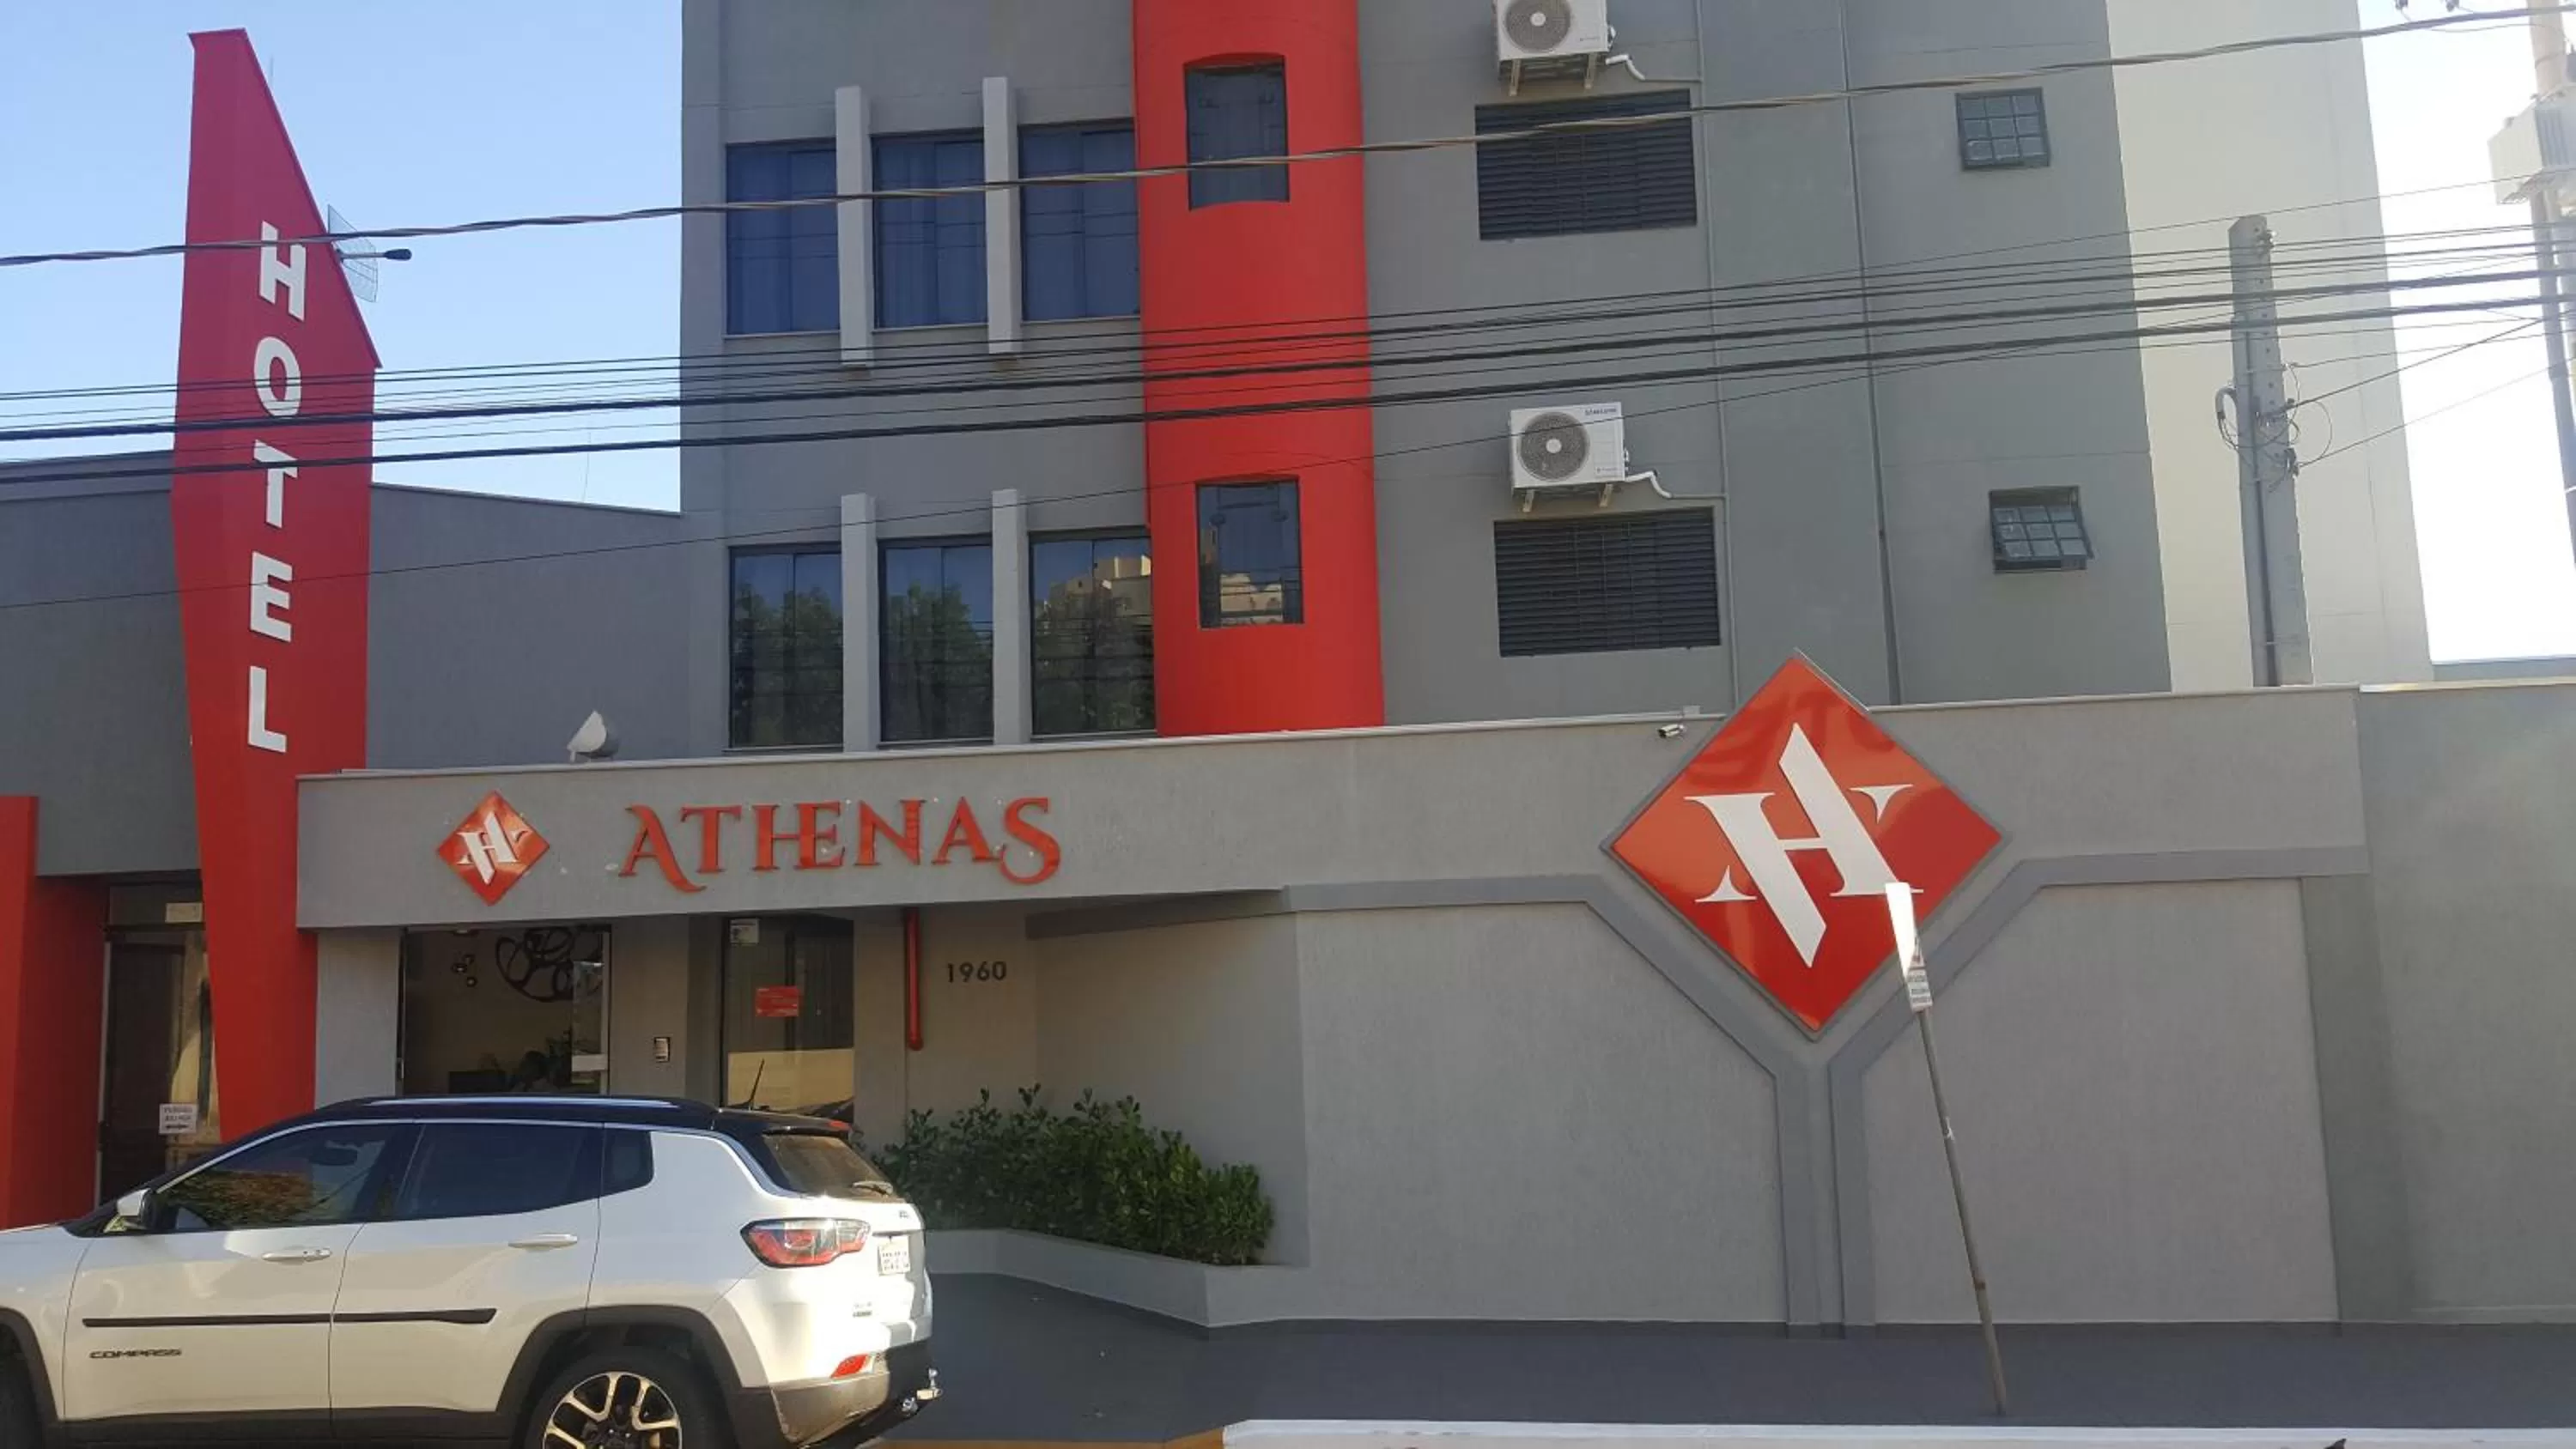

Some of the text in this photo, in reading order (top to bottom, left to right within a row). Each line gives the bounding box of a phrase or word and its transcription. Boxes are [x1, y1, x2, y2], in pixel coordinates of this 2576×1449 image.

[247, 221, 307, 753] HOTEL
[618, 796, 1060, 893] ATHENAS
[947, 961, 1007, 983] 1960
[88, 1349, 182, 1359] COMPASS
